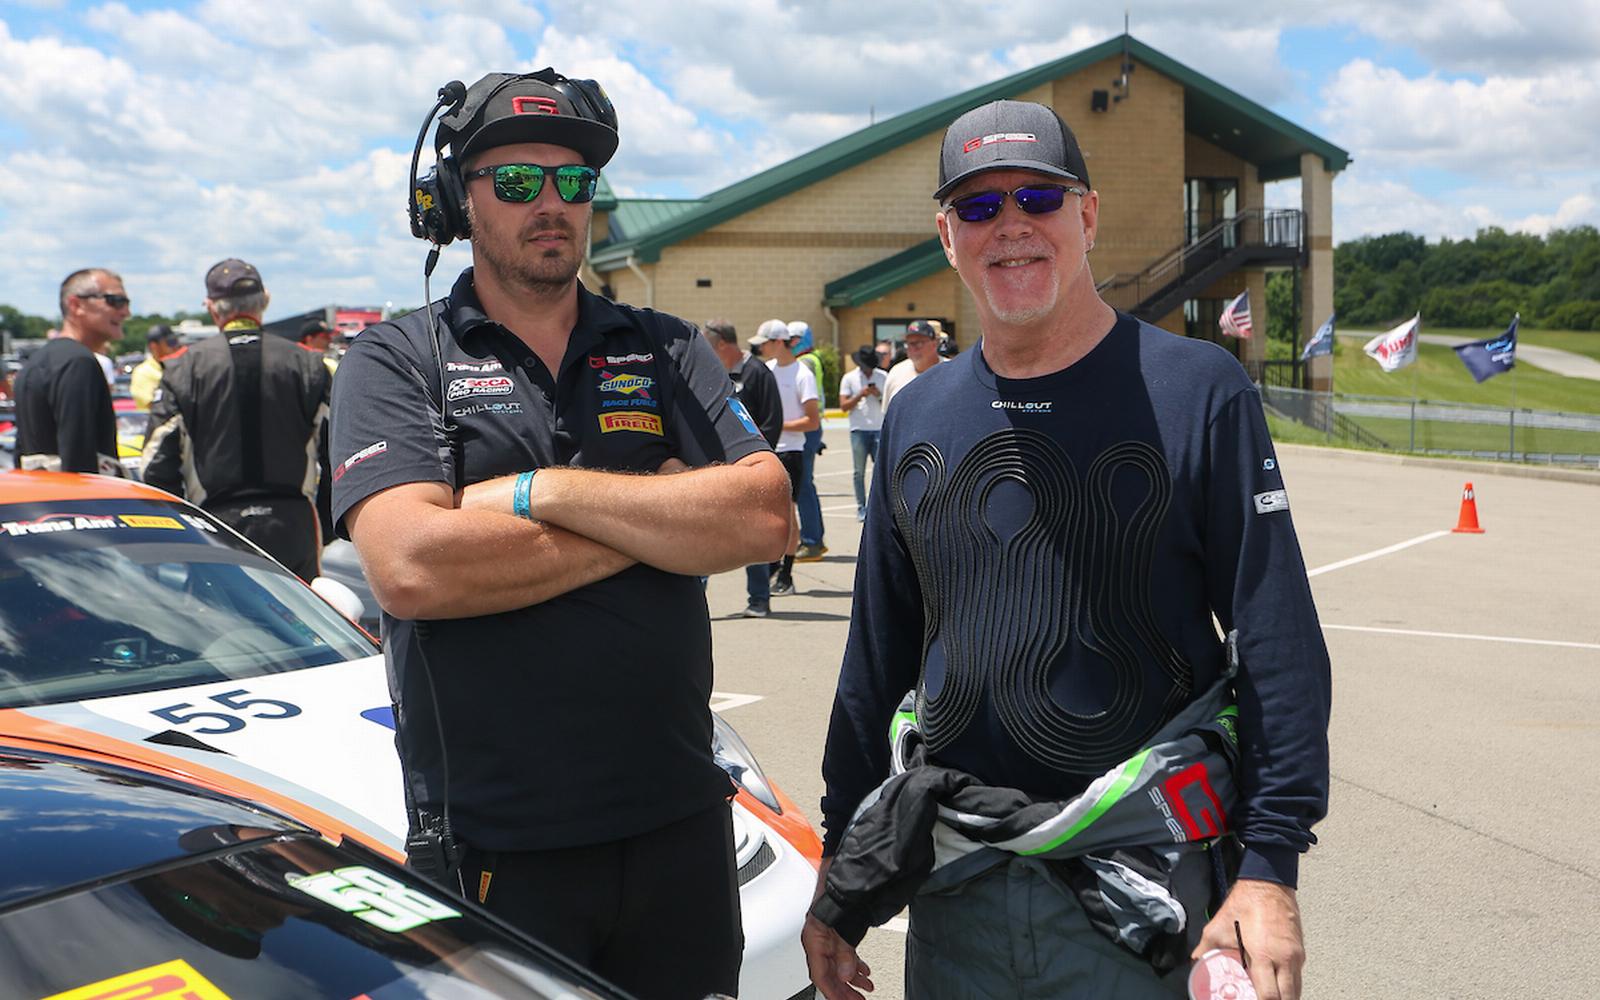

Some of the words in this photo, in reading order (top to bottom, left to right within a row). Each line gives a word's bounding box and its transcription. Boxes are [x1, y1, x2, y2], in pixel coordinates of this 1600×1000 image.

[466, 379, 510, 387] SCCA
[601, 377, 651, 391] SUNOCO
[450, 389, 470, 399] PRO
[471, 386, 510, 394] RACING
[452, 402, 521, 417] CHILLOUT
[991, 400, 1052, 409] CHILLOUT
[604, 414, 659, 432] PIRELLI
[1, 520, 75, 537] Trans
[74, 516, 118, 530] Am
[148, 689, 303, 735] 55
